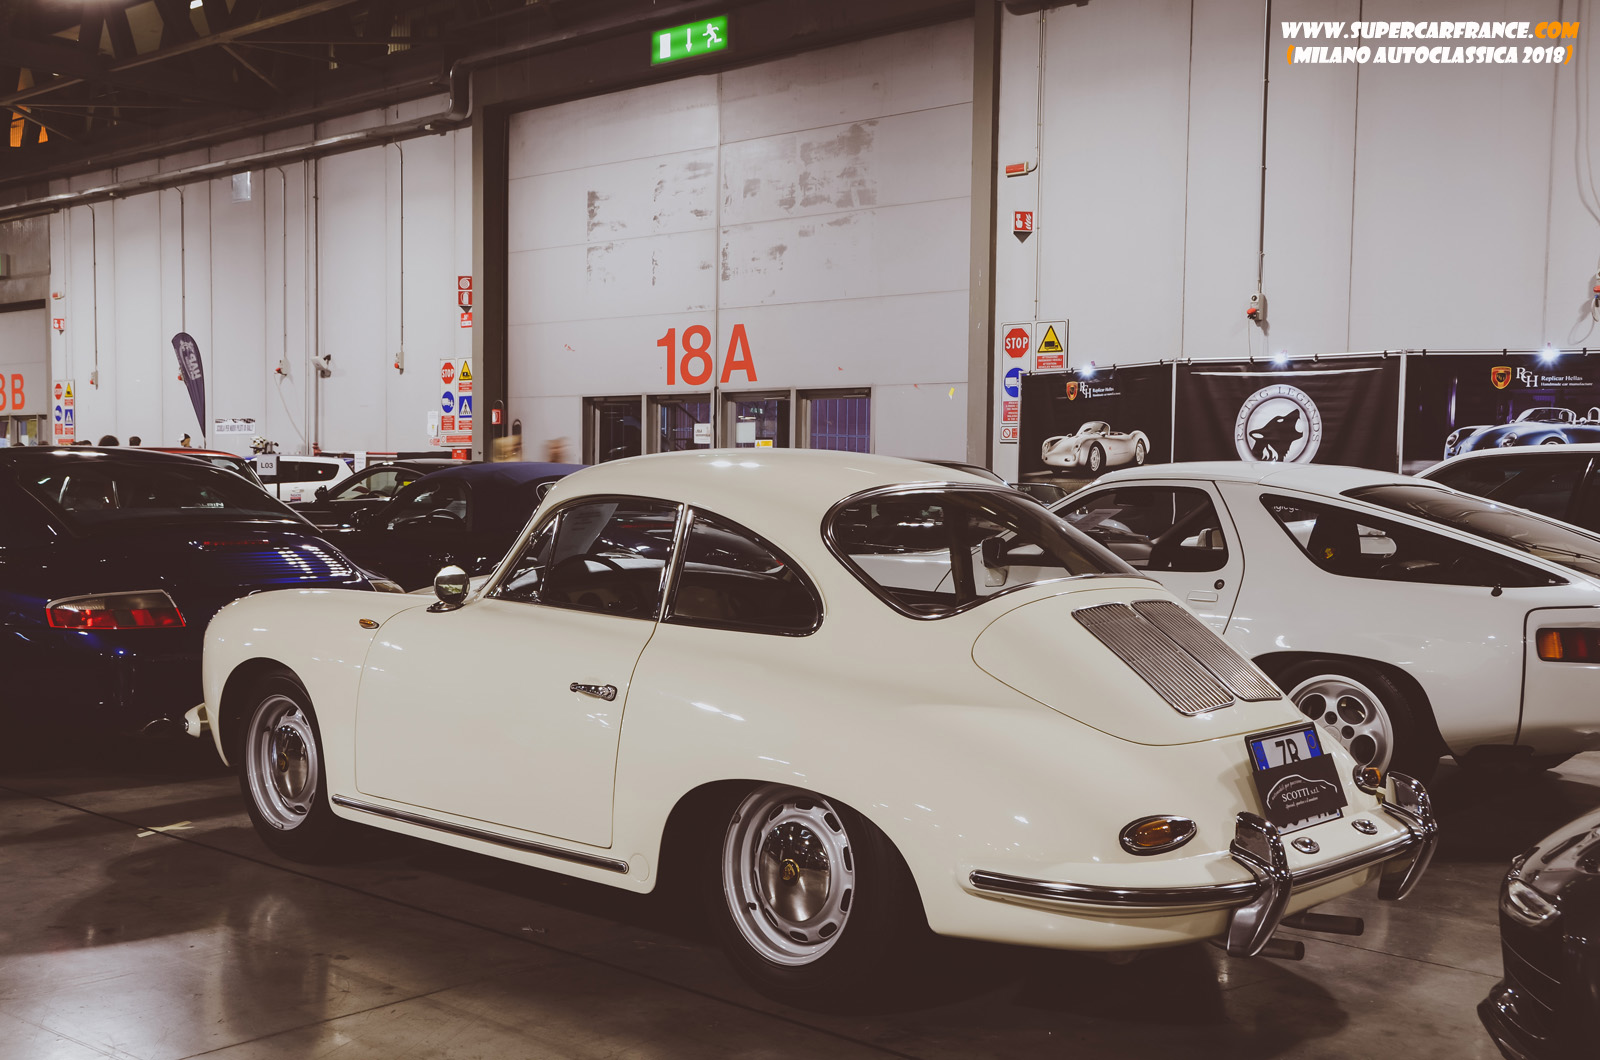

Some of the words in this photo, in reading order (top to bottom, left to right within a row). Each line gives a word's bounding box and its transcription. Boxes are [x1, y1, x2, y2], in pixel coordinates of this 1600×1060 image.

[1005, 336, 1029, 350] STOP
[656, 323, 758, 386] 18A
[441, 368, 455, 378] STOP
[1236, 389, 1269, 442] RACING
[1278, 386, 1321, 442] LEGENDS
[1281, 787, 1310, 802] SCOTTI
